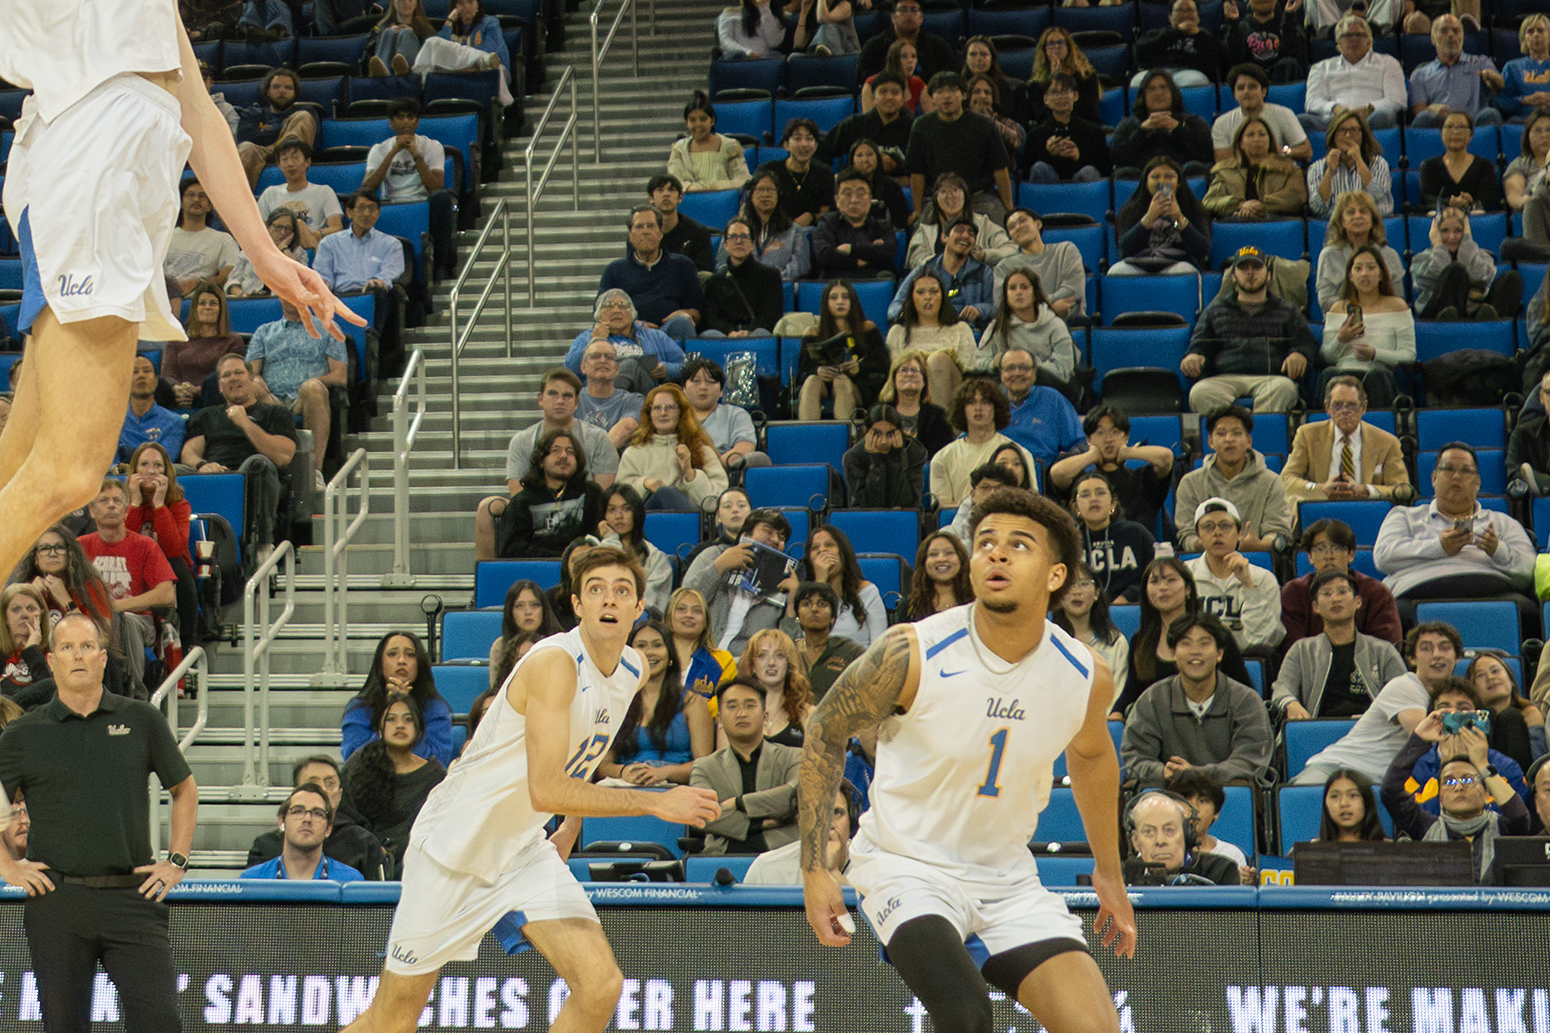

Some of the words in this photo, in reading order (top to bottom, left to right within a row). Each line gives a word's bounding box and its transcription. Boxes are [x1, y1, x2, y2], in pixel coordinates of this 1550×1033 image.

[986, 698, 1027, 721] Ucla
[565, 734, 610, 781] 12
[976, 727, 1011, 798] 1
[596, 888, 643, 899] WESCOM
[644, 888, 698, 899] FINANCIAL
[1427, 891, 1478, 905] presented
[1481, 892, 1495, 906] by
[1497, 892, 1548, 904] WESCOM
[392, 943, 419, 964] Ucla
[693, 979, 816, 1032] HERE
[1226, 985, 1391, 1033] WE'RE
